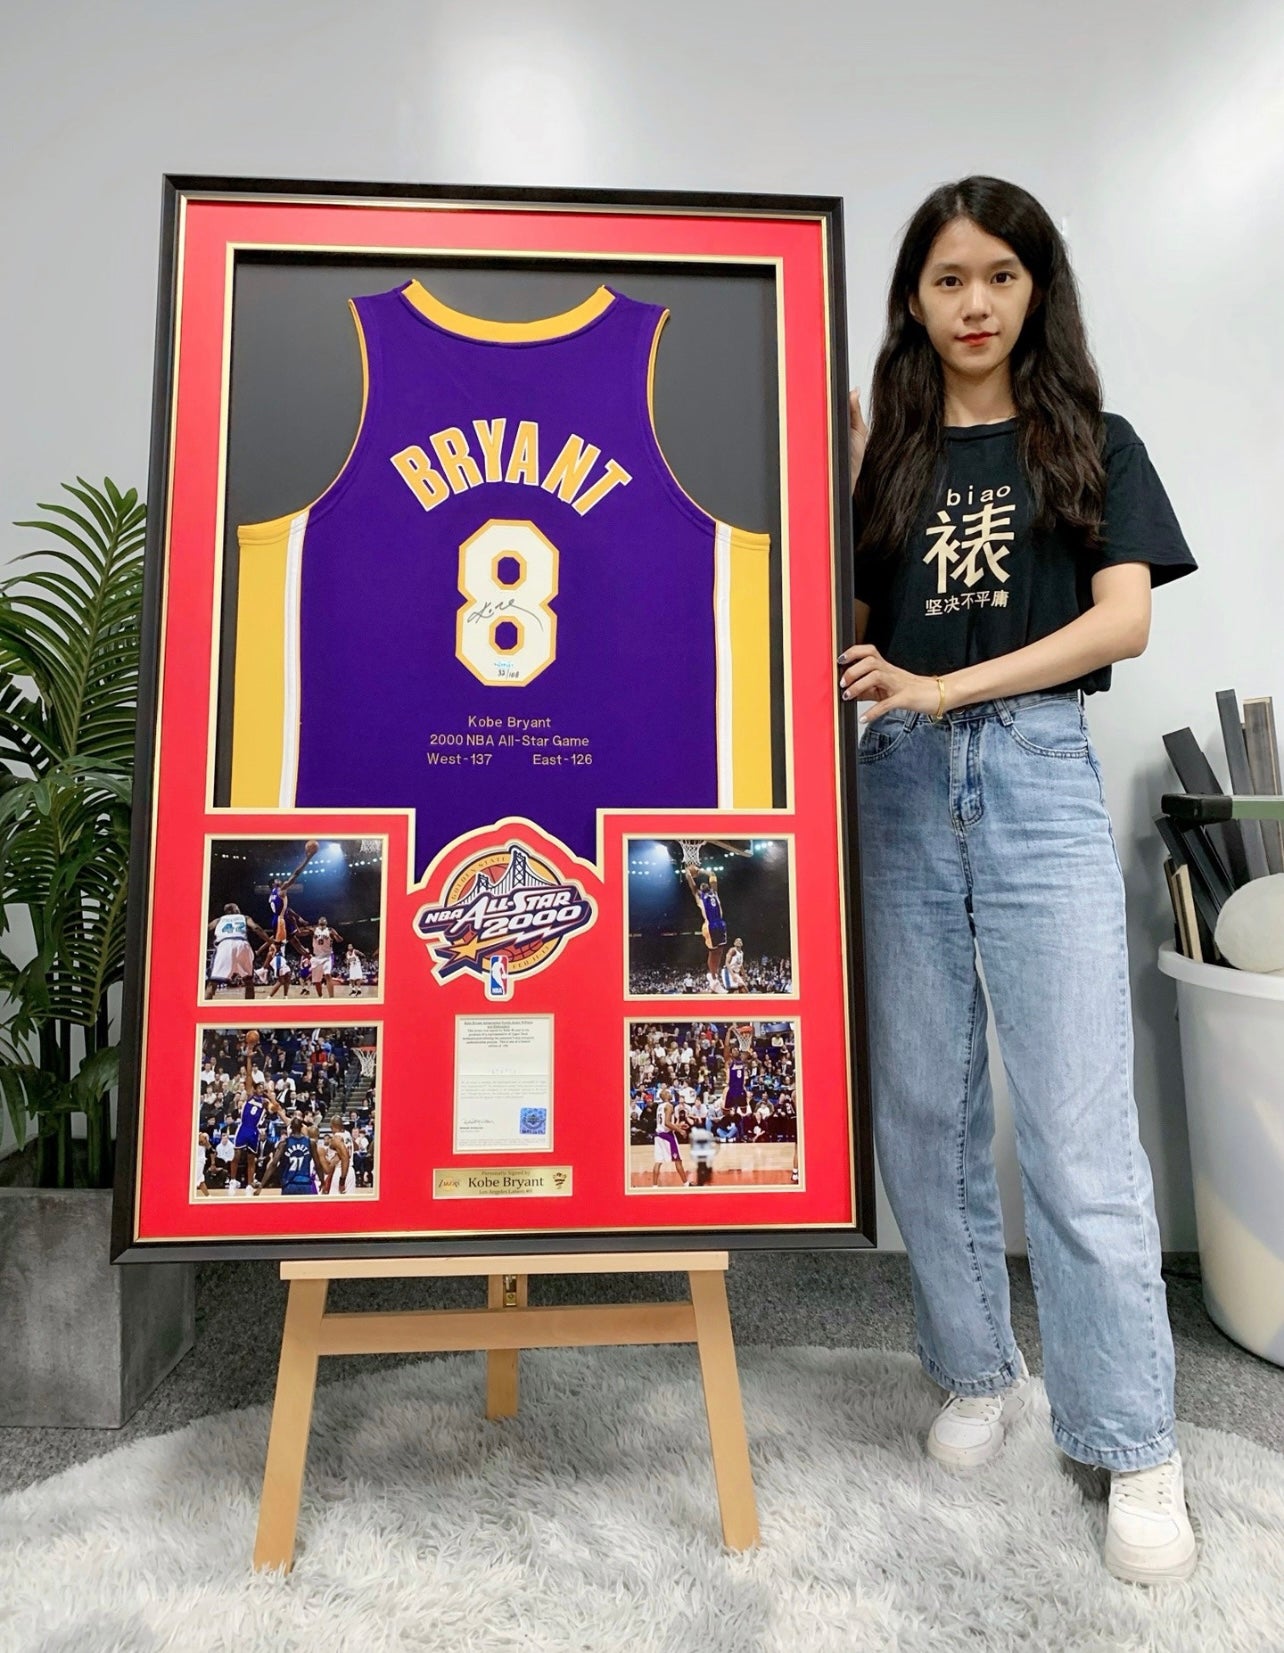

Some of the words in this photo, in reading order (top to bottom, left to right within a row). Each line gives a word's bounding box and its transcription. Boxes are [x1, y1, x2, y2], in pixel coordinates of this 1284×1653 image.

[390, 418, 632, 516] BRYANT
[946, 485, 1011, 506] biao
[922, 503, 1016, 594] 裱
[455, 519, 559, 686] 8
[925, 590, 1009, 616] 坚决不平庸
[468, 716, 503, 728] Kobe
[507, 716, 552, 730] Bryant
[430, 734, 463, 746] 2000
[466, 735, 494, 746] NBA
[498, 735, 549, 746] All-Star
[552, 735, 589, 746] Game
[427, 753, 493, 765] West-137
[533, 753, 593, 766] East-126
[425, 909, 464, 924] NBA
[480, 906, 582, 940] 2000
[468, 1177, 500, 1188] Kobe
[503, 1176, 544, 1189] Bryant
